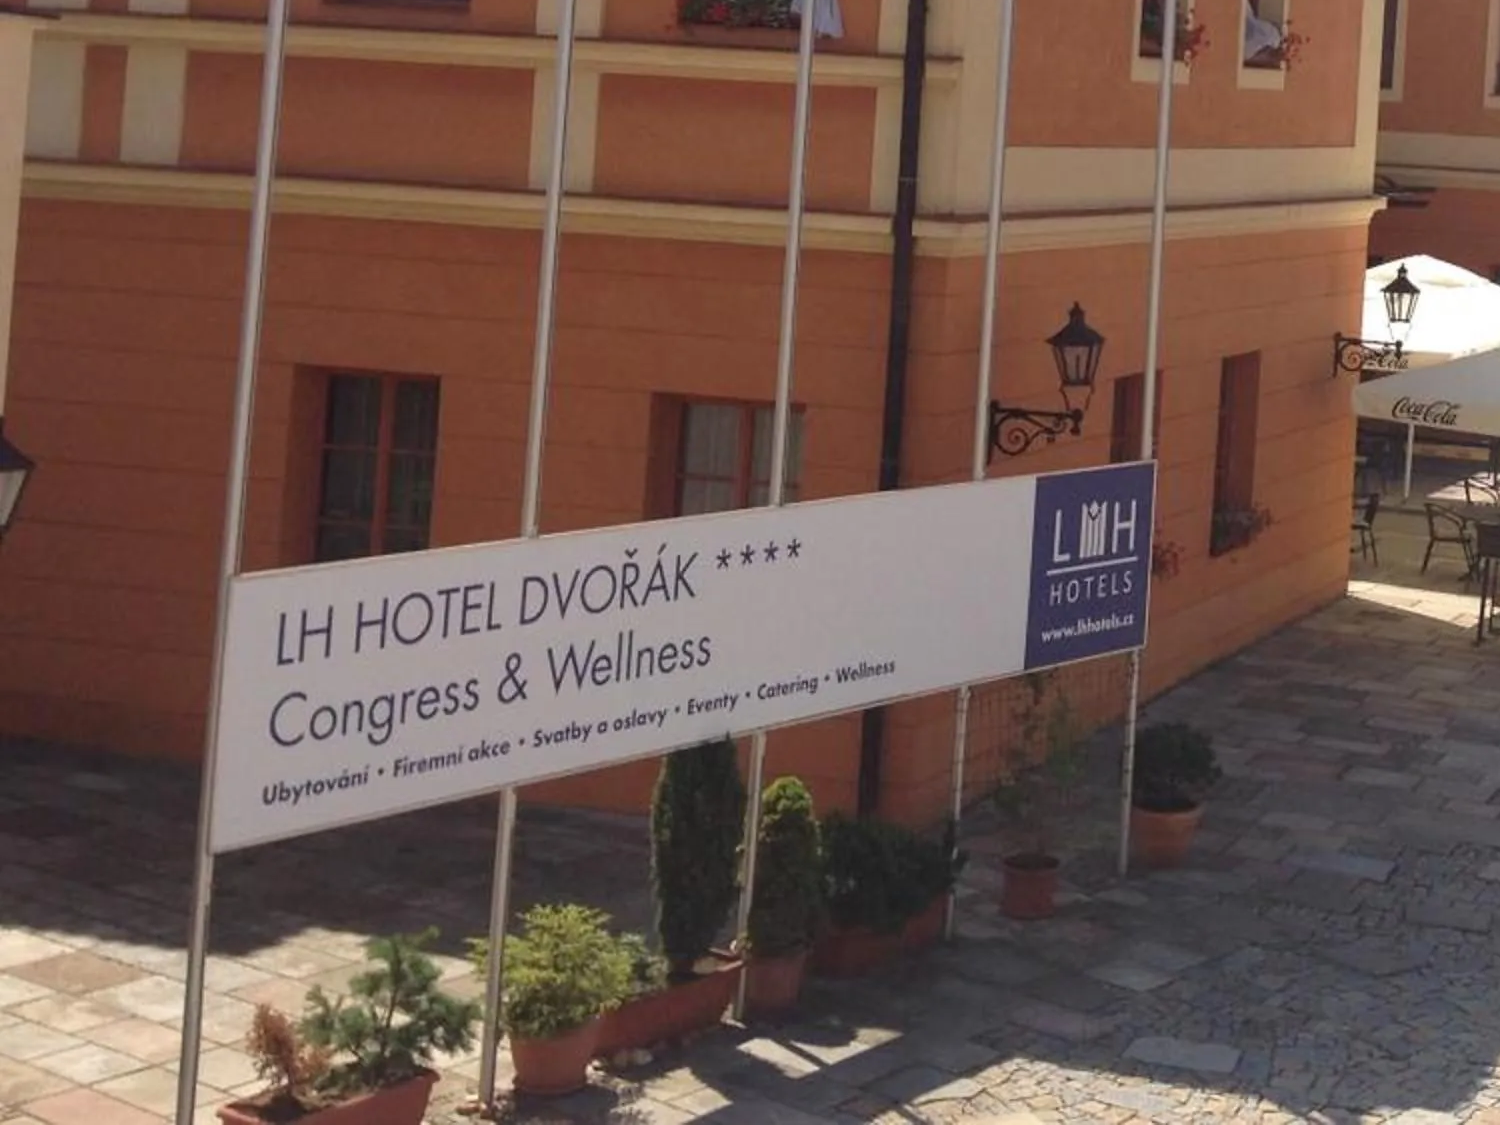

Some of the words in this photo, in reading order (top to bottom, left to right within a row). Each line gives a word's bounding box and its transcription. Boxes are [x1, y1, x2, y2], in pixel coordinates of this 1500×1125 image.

[276, 605, 334, 666] LH
[353, 581, 503, 654] HOTEL
[519, 543, 699, 626] DVOŘÁK
[1050, 570, 1133, 606] HOTELS
[262, 763, 370, 806] Ubytování
[392, 747, 464, 778] Firemní
[467, 739, 512, 763] akce
[532, 720, 592, 749] Svatby
[597, 721, 609, 735] a
[613, 706, 669, 728] oslavy
[687, 691, 739, 716] Eventy
[757, 675, 820, 701] Catering
[835, 659, 896, 684] Wellness
[269, 677, 481, 747] Congress
[496, 652, 529, 704] &
[546, 631, 712, 695] Wellness
